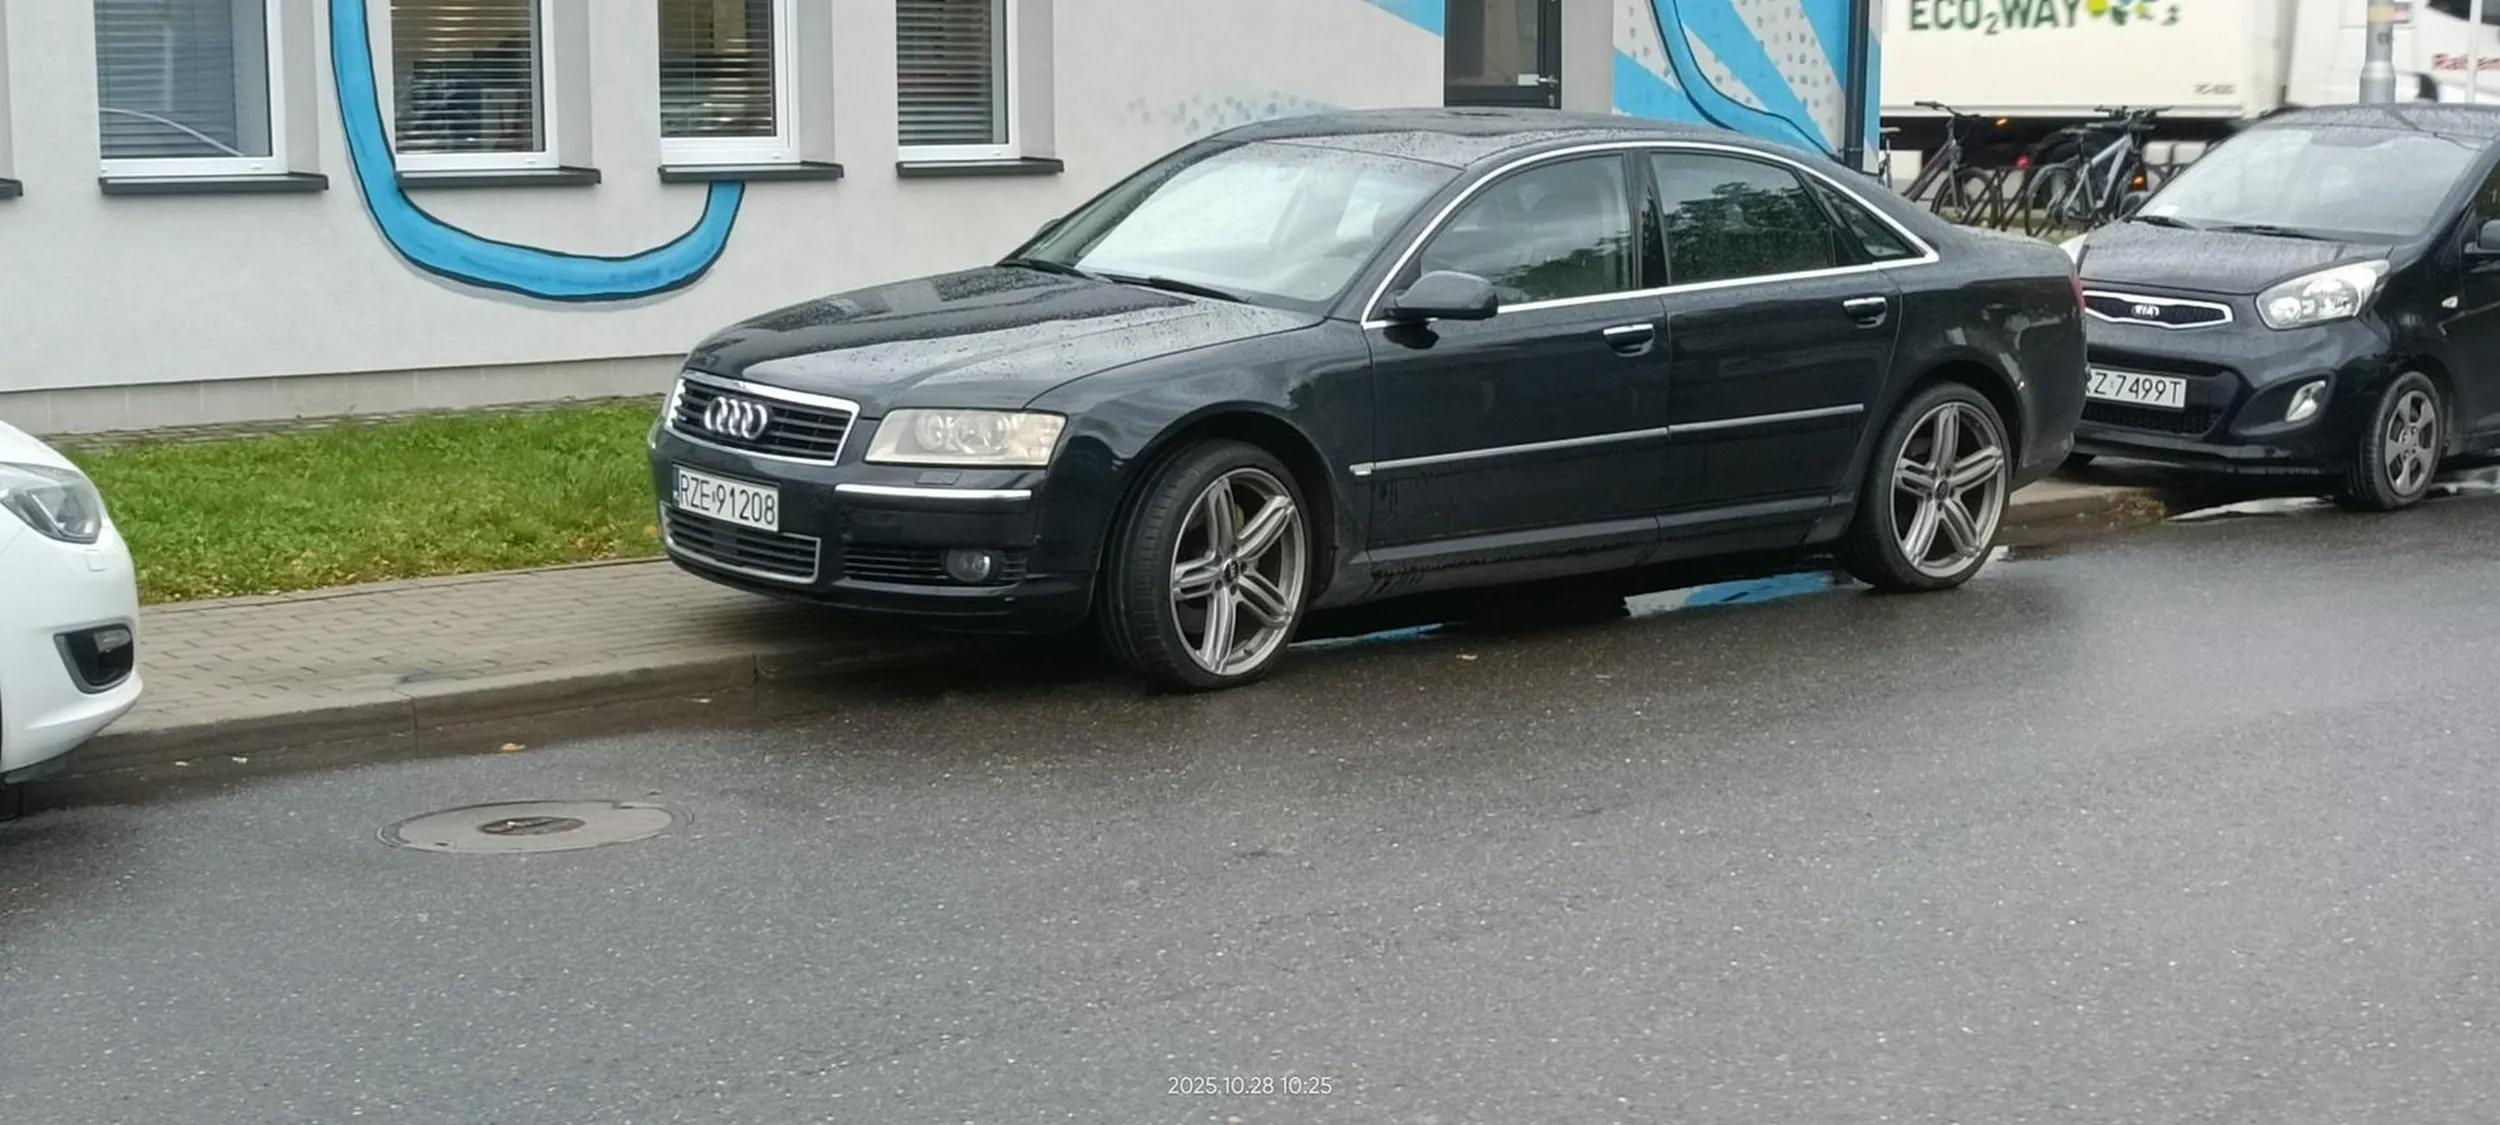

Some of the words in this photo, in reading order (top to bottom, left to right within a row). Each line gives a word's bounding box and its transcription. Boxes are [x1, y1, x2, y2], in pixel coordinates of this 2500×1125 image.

[2115, 374, 2182, 404] 7499T
[680, 474, 710, 510] RZE
[716, 484, 775, 525] 91208
